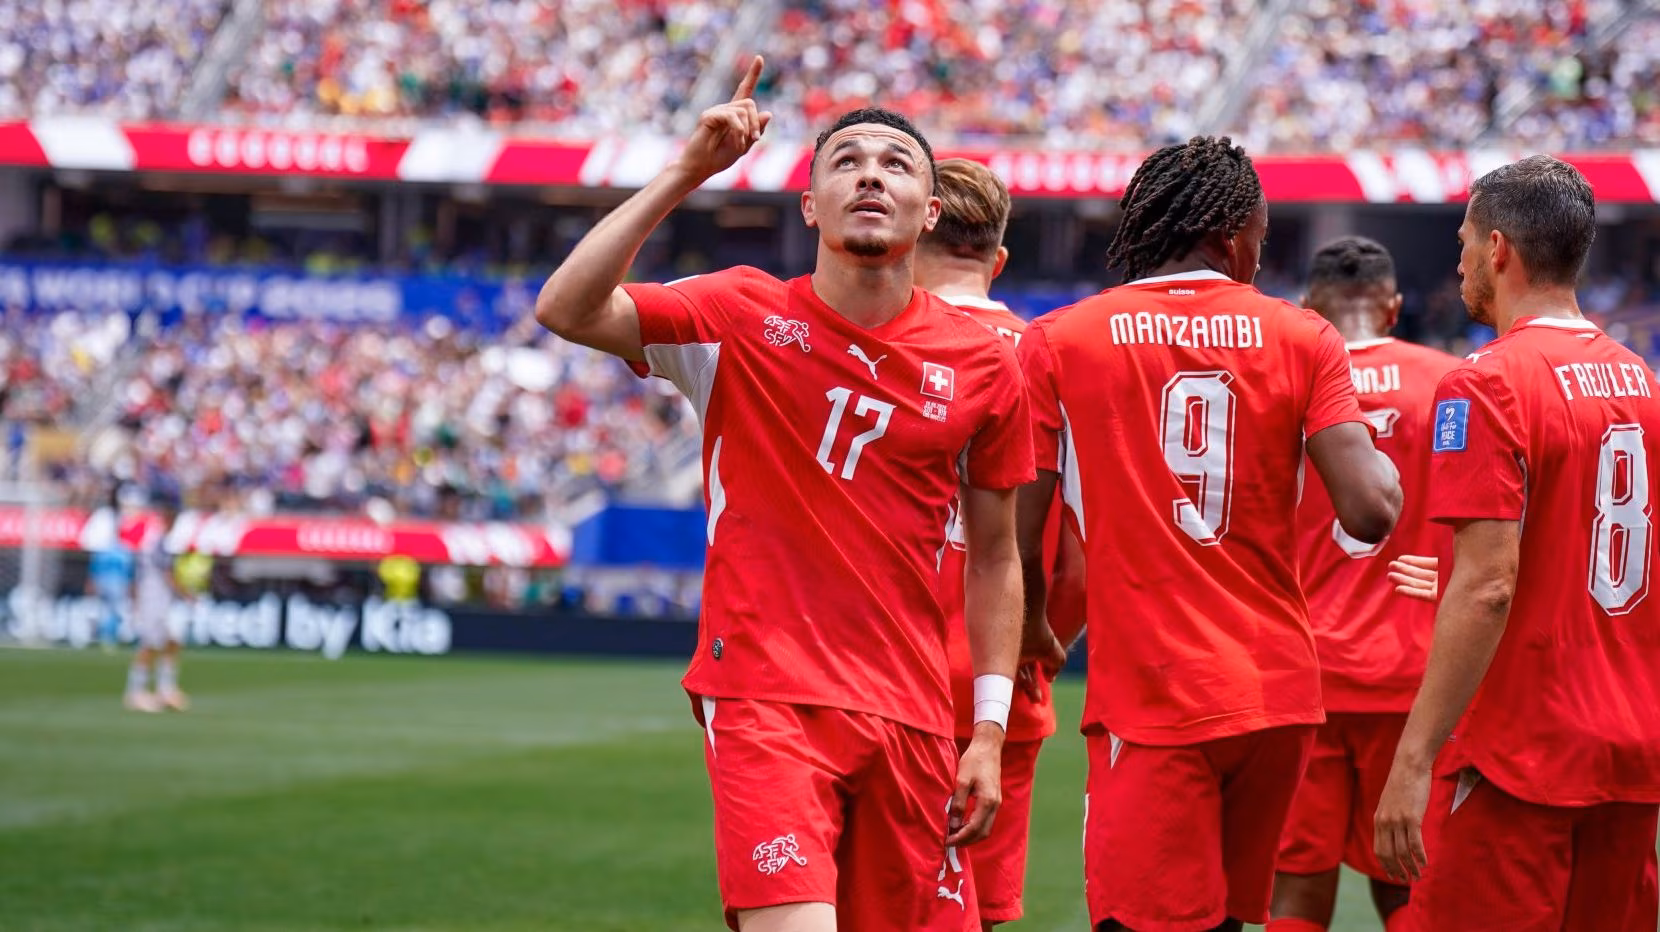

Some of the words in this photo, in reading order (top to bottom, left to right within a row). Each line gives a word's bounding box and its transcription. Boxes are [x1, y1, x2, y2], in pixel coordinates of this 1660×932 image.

[1168, 288, 1195, 296] suisse
[1110, 312, 1263, 348] MANZAMBI
[1351, 364, 1400, 394] ANJI
[1554, 362, 1652, 400] FREULER
[816, 386, 896, 480] 17
[1160, 370, 1236, 546] 9
[1588, 423, 1652, 616] 8
[285, 593, 357, 660] by
[361, 595, 452, 654] Kia
